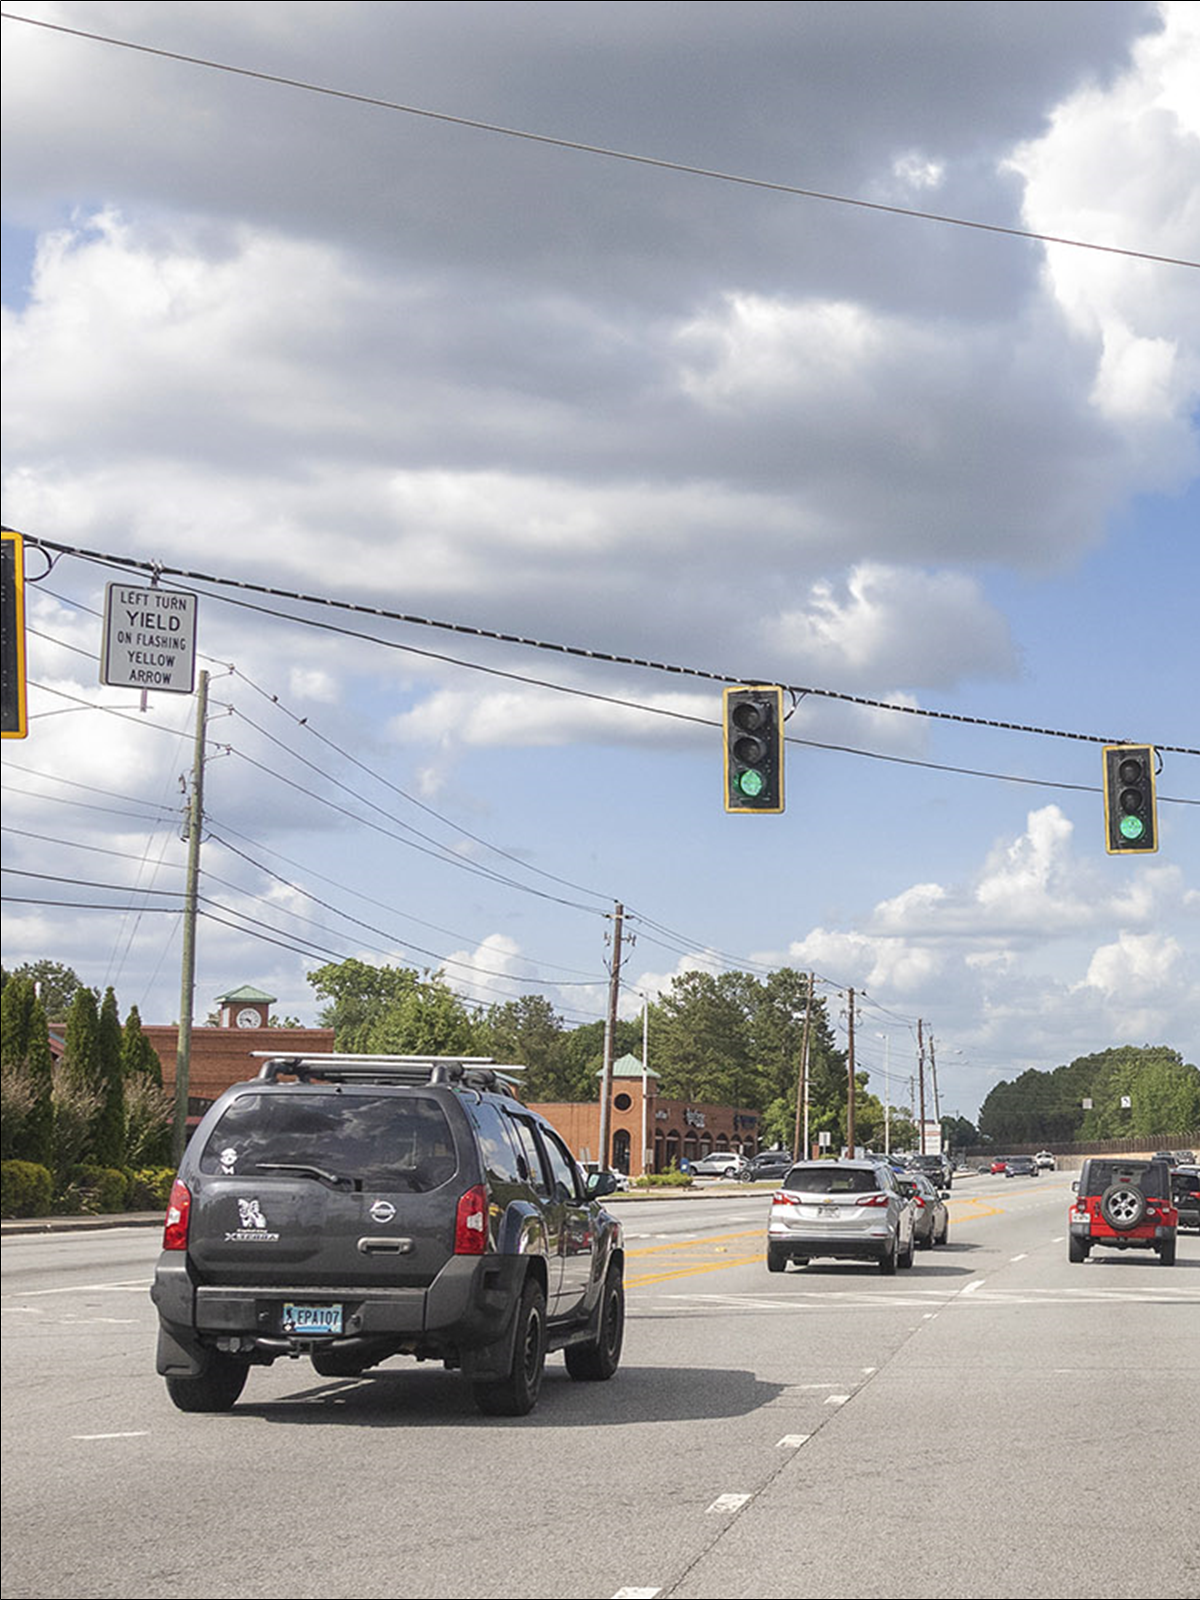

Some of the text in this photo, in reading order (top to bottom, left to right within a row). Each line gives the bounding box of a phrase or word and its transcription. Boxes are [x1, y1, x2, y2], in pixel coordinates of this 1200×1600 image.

[120, 591, 187, 611] LEFT TURN
[126, 609, 181, 632] YIELD
[117, 631, 186, 651] ON FLASHING
[127, 650, 176, 667] YELLOW
[129, 669, 172, 684] ARROW
